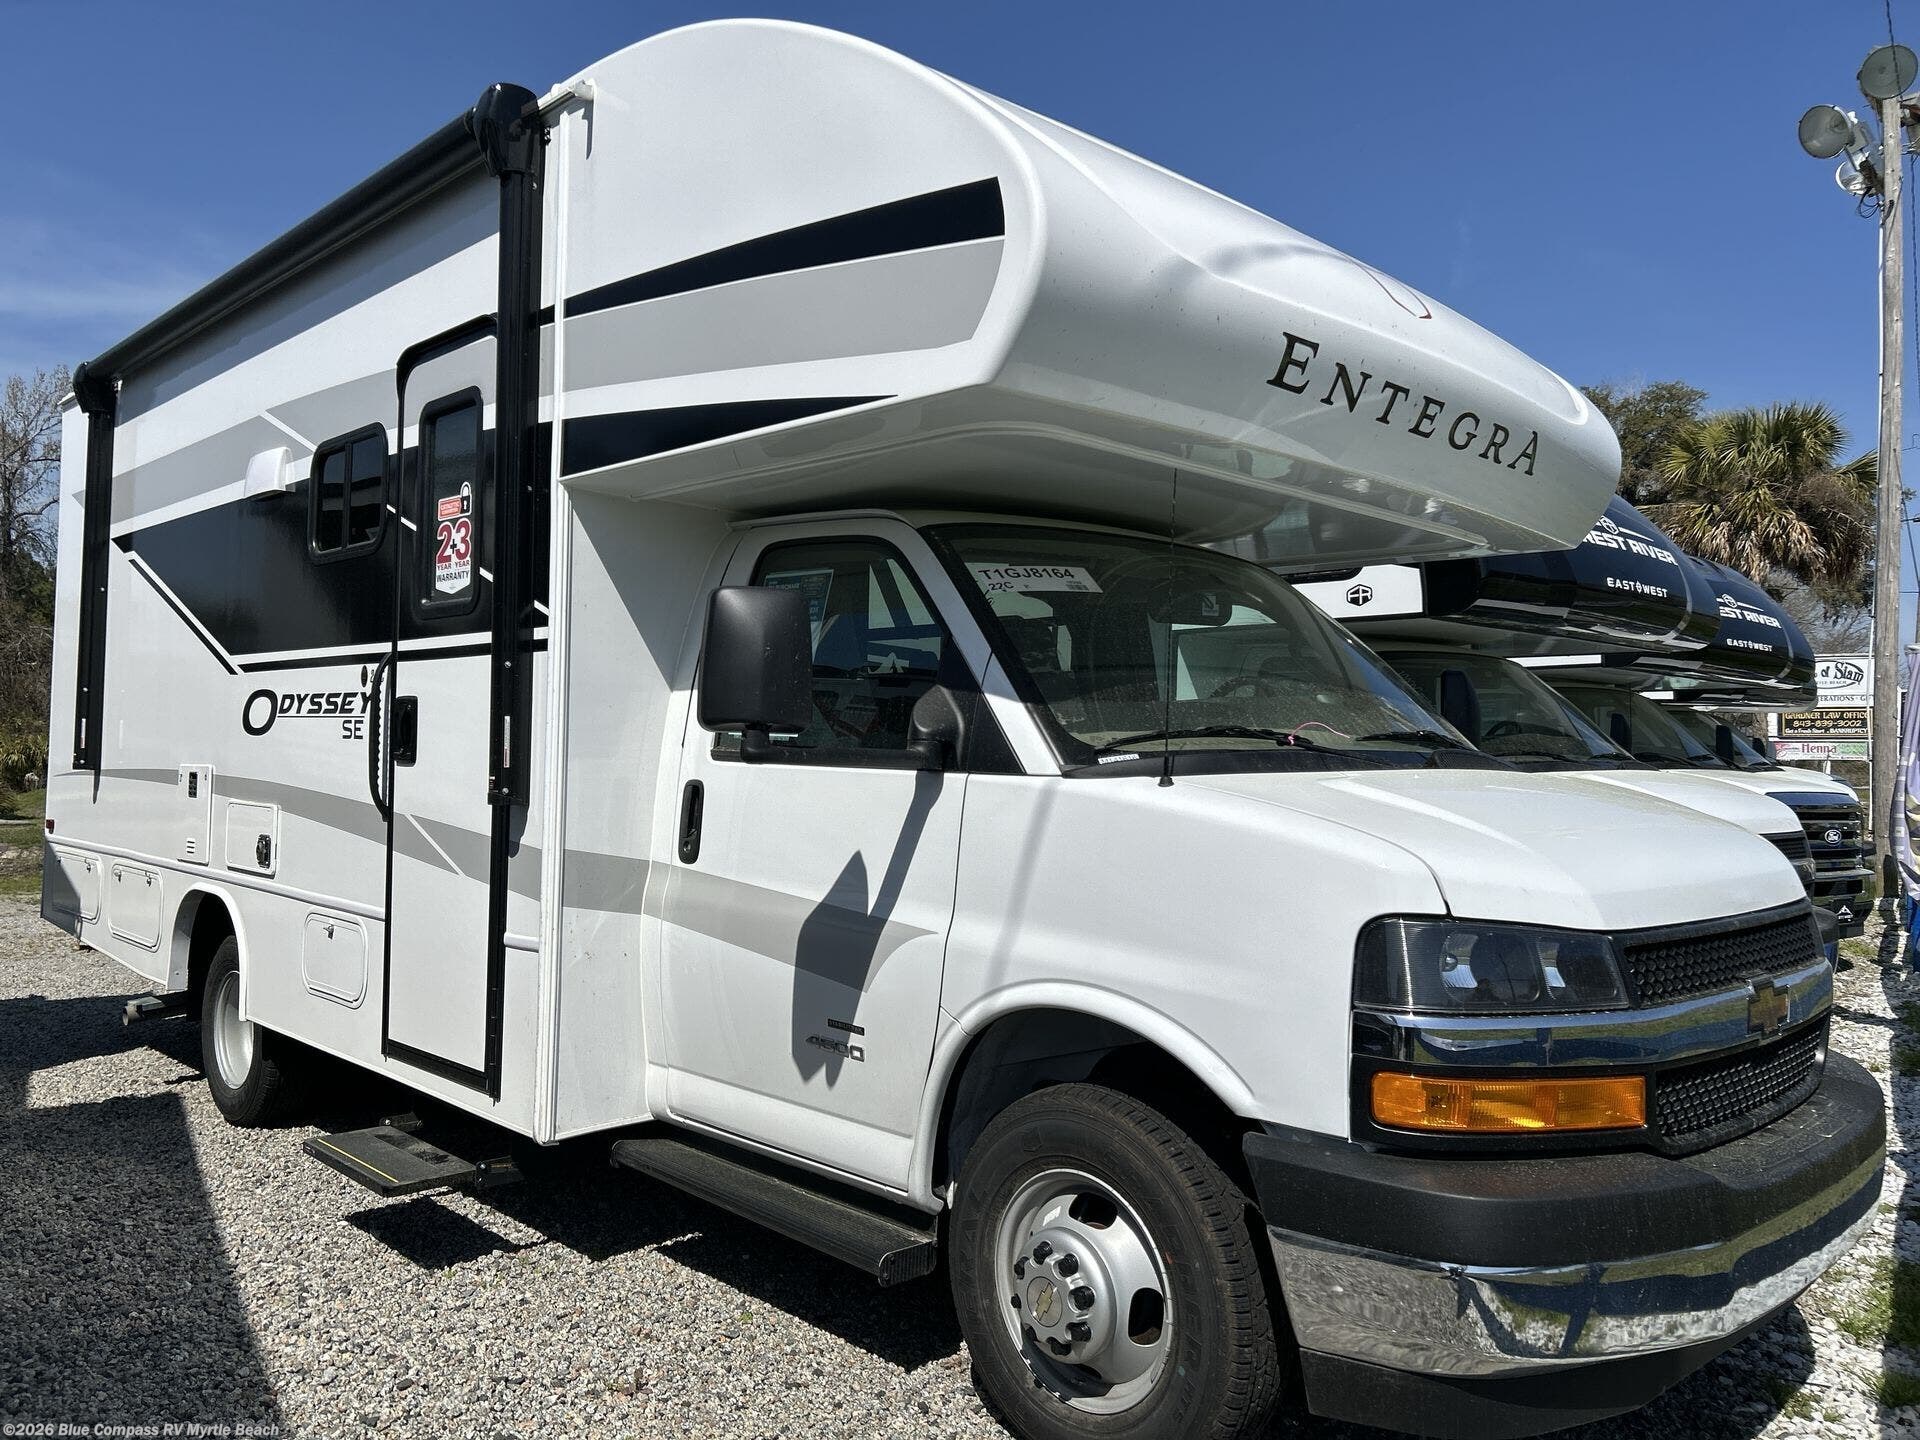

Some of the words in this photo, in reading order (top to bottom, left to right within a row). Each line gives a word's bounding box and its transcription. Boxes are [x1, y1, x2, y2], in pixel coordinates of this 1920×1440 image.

[1266, 331, 1540, 477] ENTEGRA
[1626, 538, 1679, 566] RIVER
[437, 561, 452, 572] YEAR
[454, 559, 470, 570] YEAR
[436, 569, 470, 583] WARRANTY
[977, 567, 1075, 581] T1GJ8164
[988, 581, 1015, 592] 22C
[1742, 610, 1782, 629] RIVER
[1833, 660, 1865, 686] Siam
[242, 688, 373, 737] ODYSSEY
[1785, 711, 1820, 720] GARDNER
[1823, 711, 1841, 719] LAW
[342, 719, 364, 740] SE
[1792, 719, 1862, 728] 843-839-3002
[1801, 743, 1837, 754] Henna
